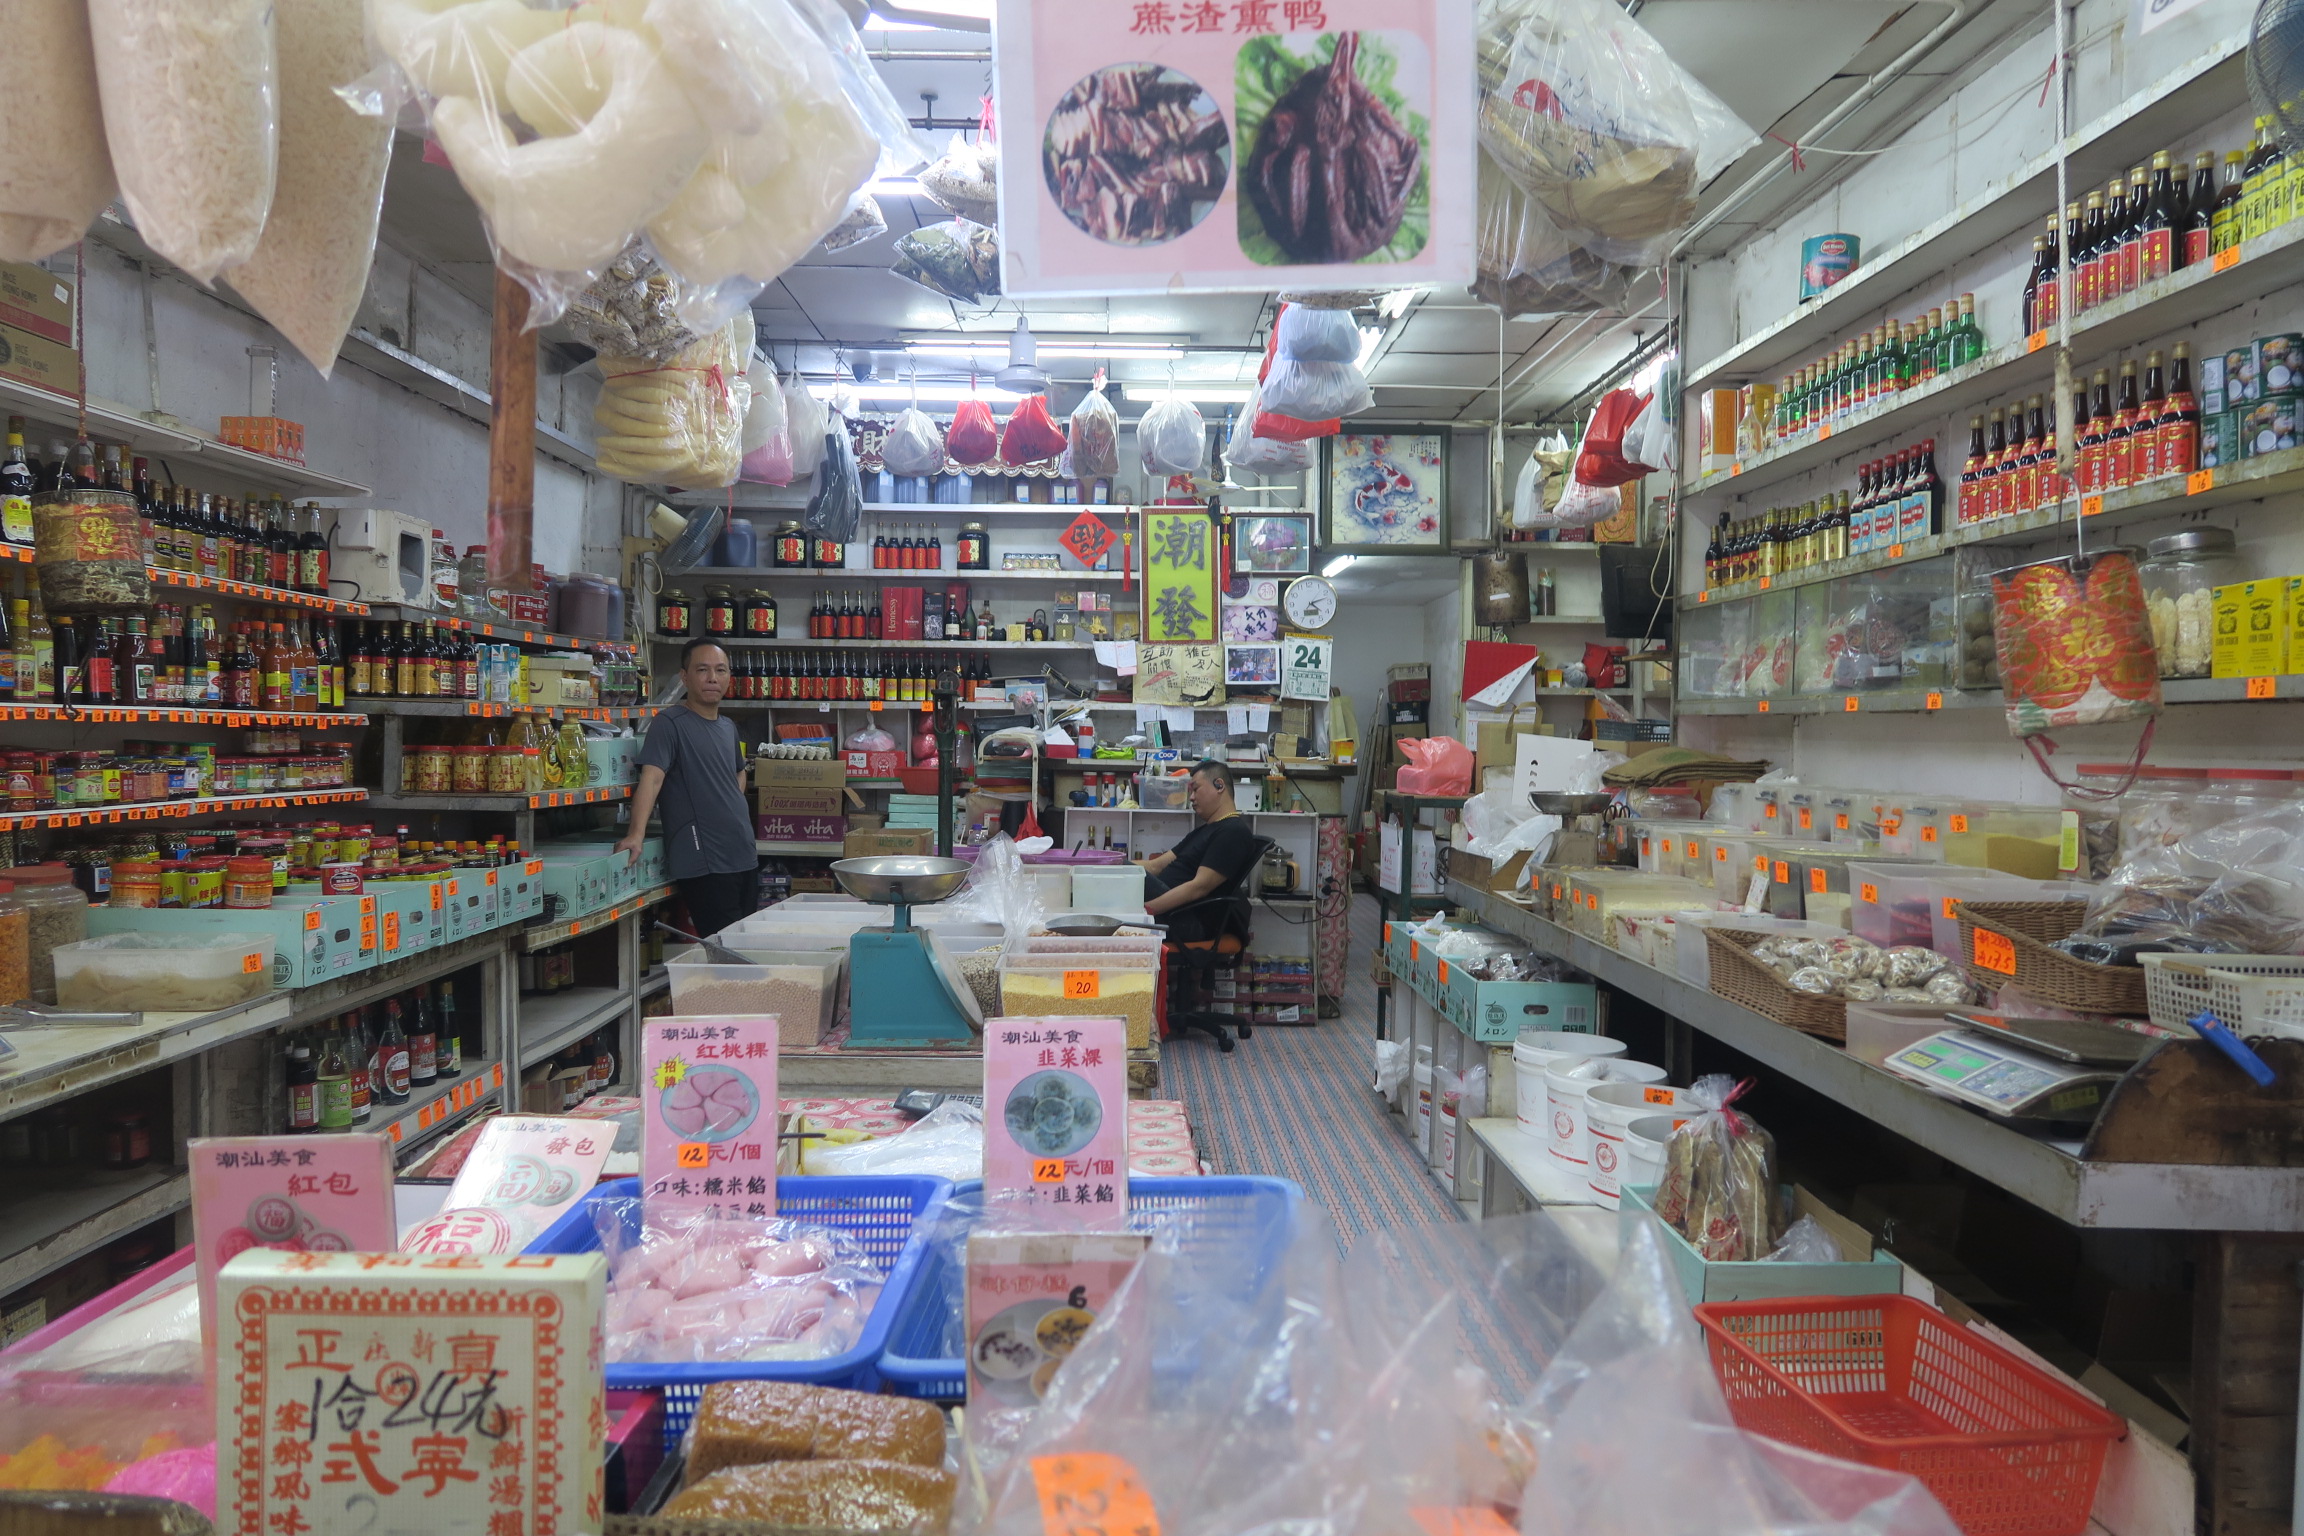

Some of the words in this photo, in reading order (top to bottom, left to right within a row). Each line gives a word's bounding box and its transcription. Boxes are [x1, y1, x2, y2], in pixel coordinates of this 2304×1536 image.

[888, 597, 898, 633] Hennessy
[1294, 644, 1322, 669] 24
[764, 817, 795, 834] vita
[804, 818, 834, 835] vita
[310, 965, 327, 977] メロン
[661, 1026, 739, 1040] 潮汕美食
[1001, 1029, 1084, 1044] 潮汕美食
[1483, 1026, 1509, 1036] メロン
[696, 1042, 769, 1060] 红桃粿
[664, 1061, 677, 1089] 招牌
[544, 1137, 597, 1157] 發包
[682, 1147, 704, 1162] 12
[708, 1142, 762, 1163] 元/個
[215, 1148, 318, 1169] 潮汕美食
[1063, 1156, 1115, 1179] 元/個
[1037, 1163, 1062, 1179] 12
[287, 1172, 360, 1198] 紅包
[1067, 1285, 1089, 1309] 6
